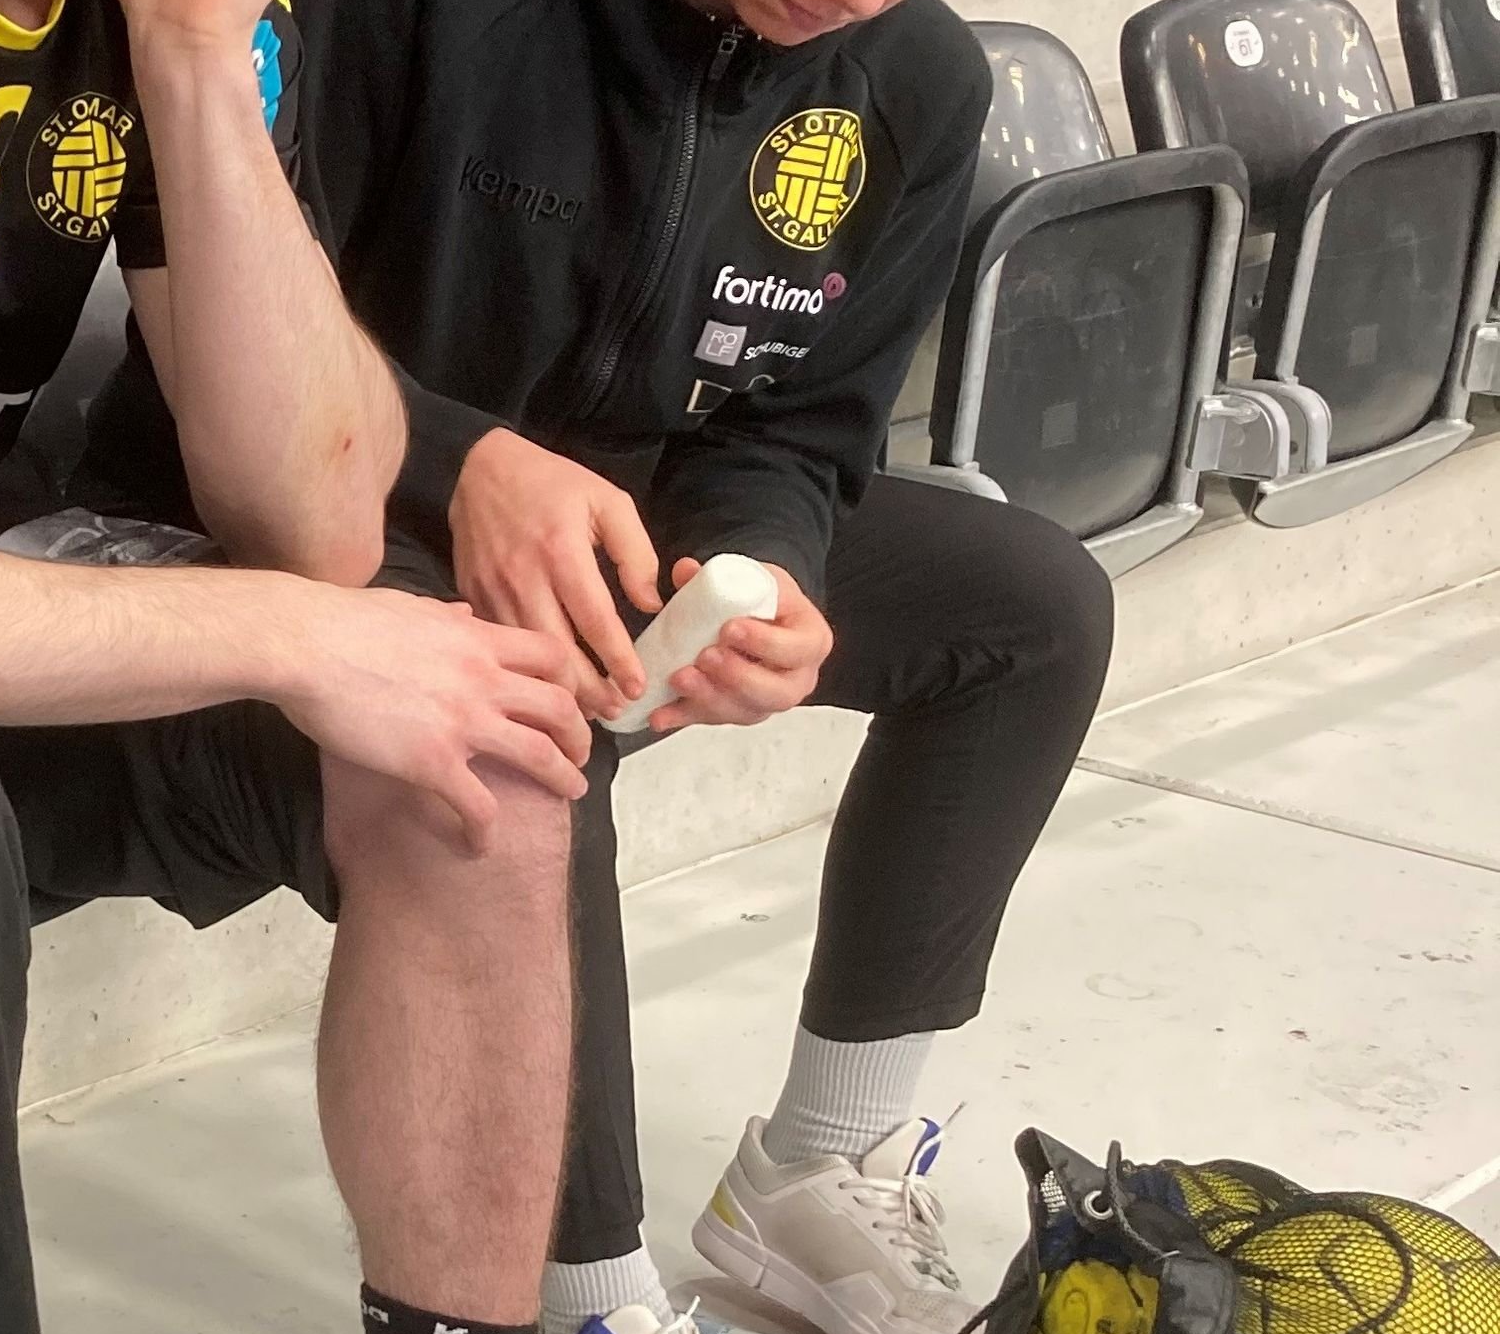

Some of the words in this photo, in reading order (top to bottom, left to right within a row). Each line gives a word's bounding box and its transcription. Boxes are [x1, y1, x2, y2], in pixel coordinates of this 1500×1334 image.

[1238, 38, 1253, 56] 61
[458, 153, 584, 226] Kempa
[712, 265, 824, 315] fortimo
